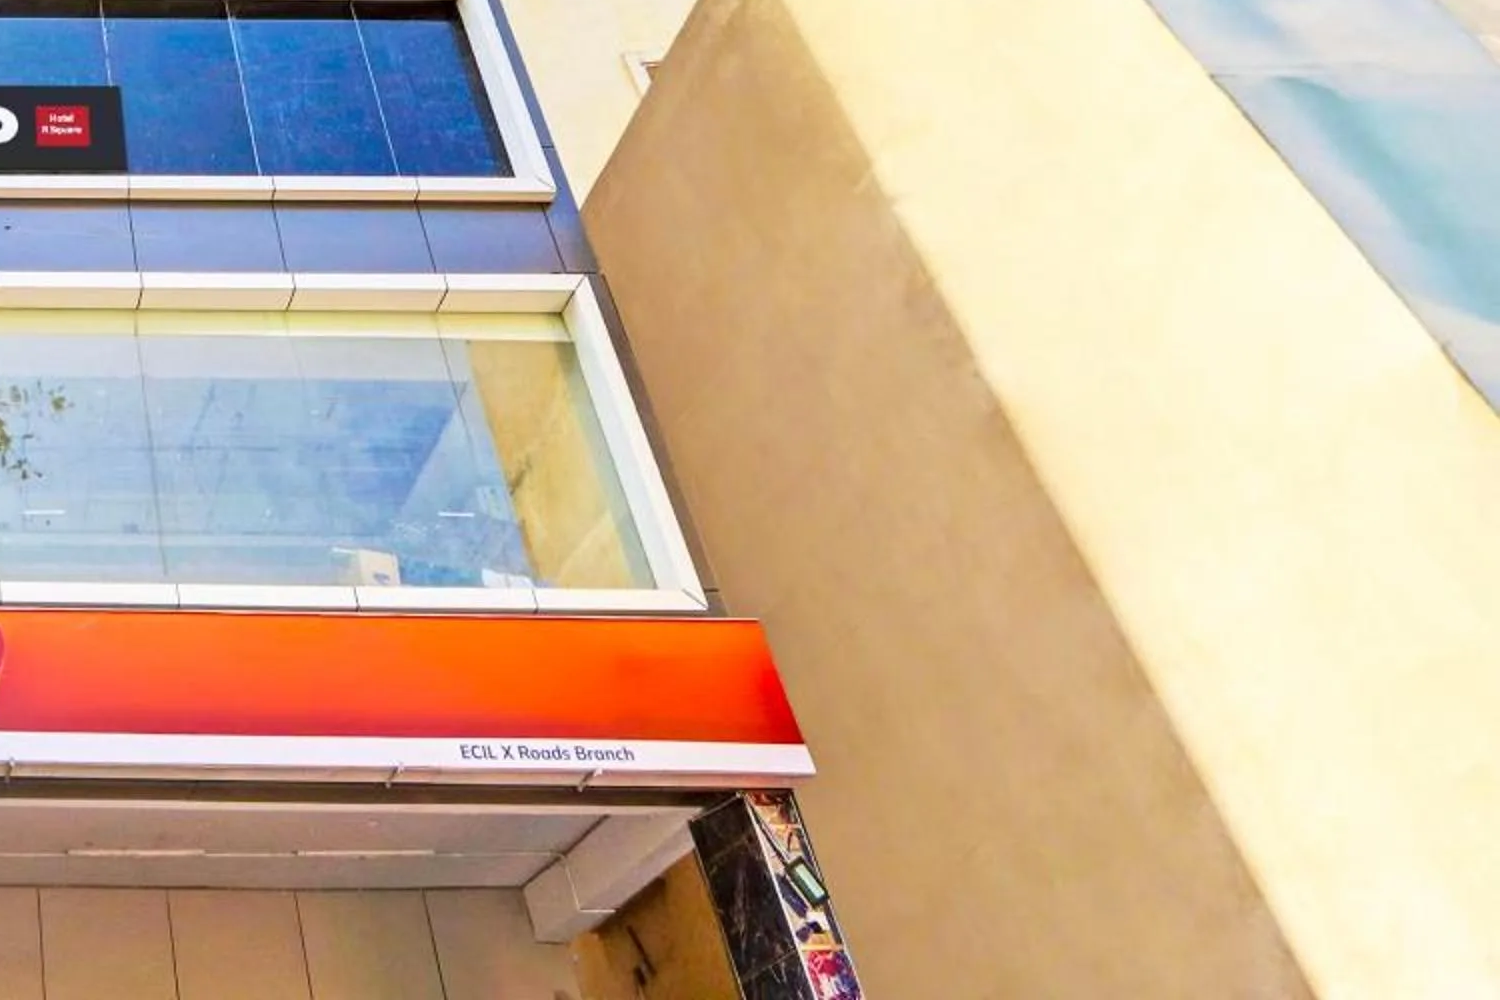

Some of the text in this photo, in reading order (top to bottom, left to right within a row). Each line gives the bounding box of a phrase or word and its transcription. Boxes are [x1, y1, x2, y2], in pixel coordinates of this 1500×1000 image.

[460, 744, 636, 762] ECIL X Roads Branch
